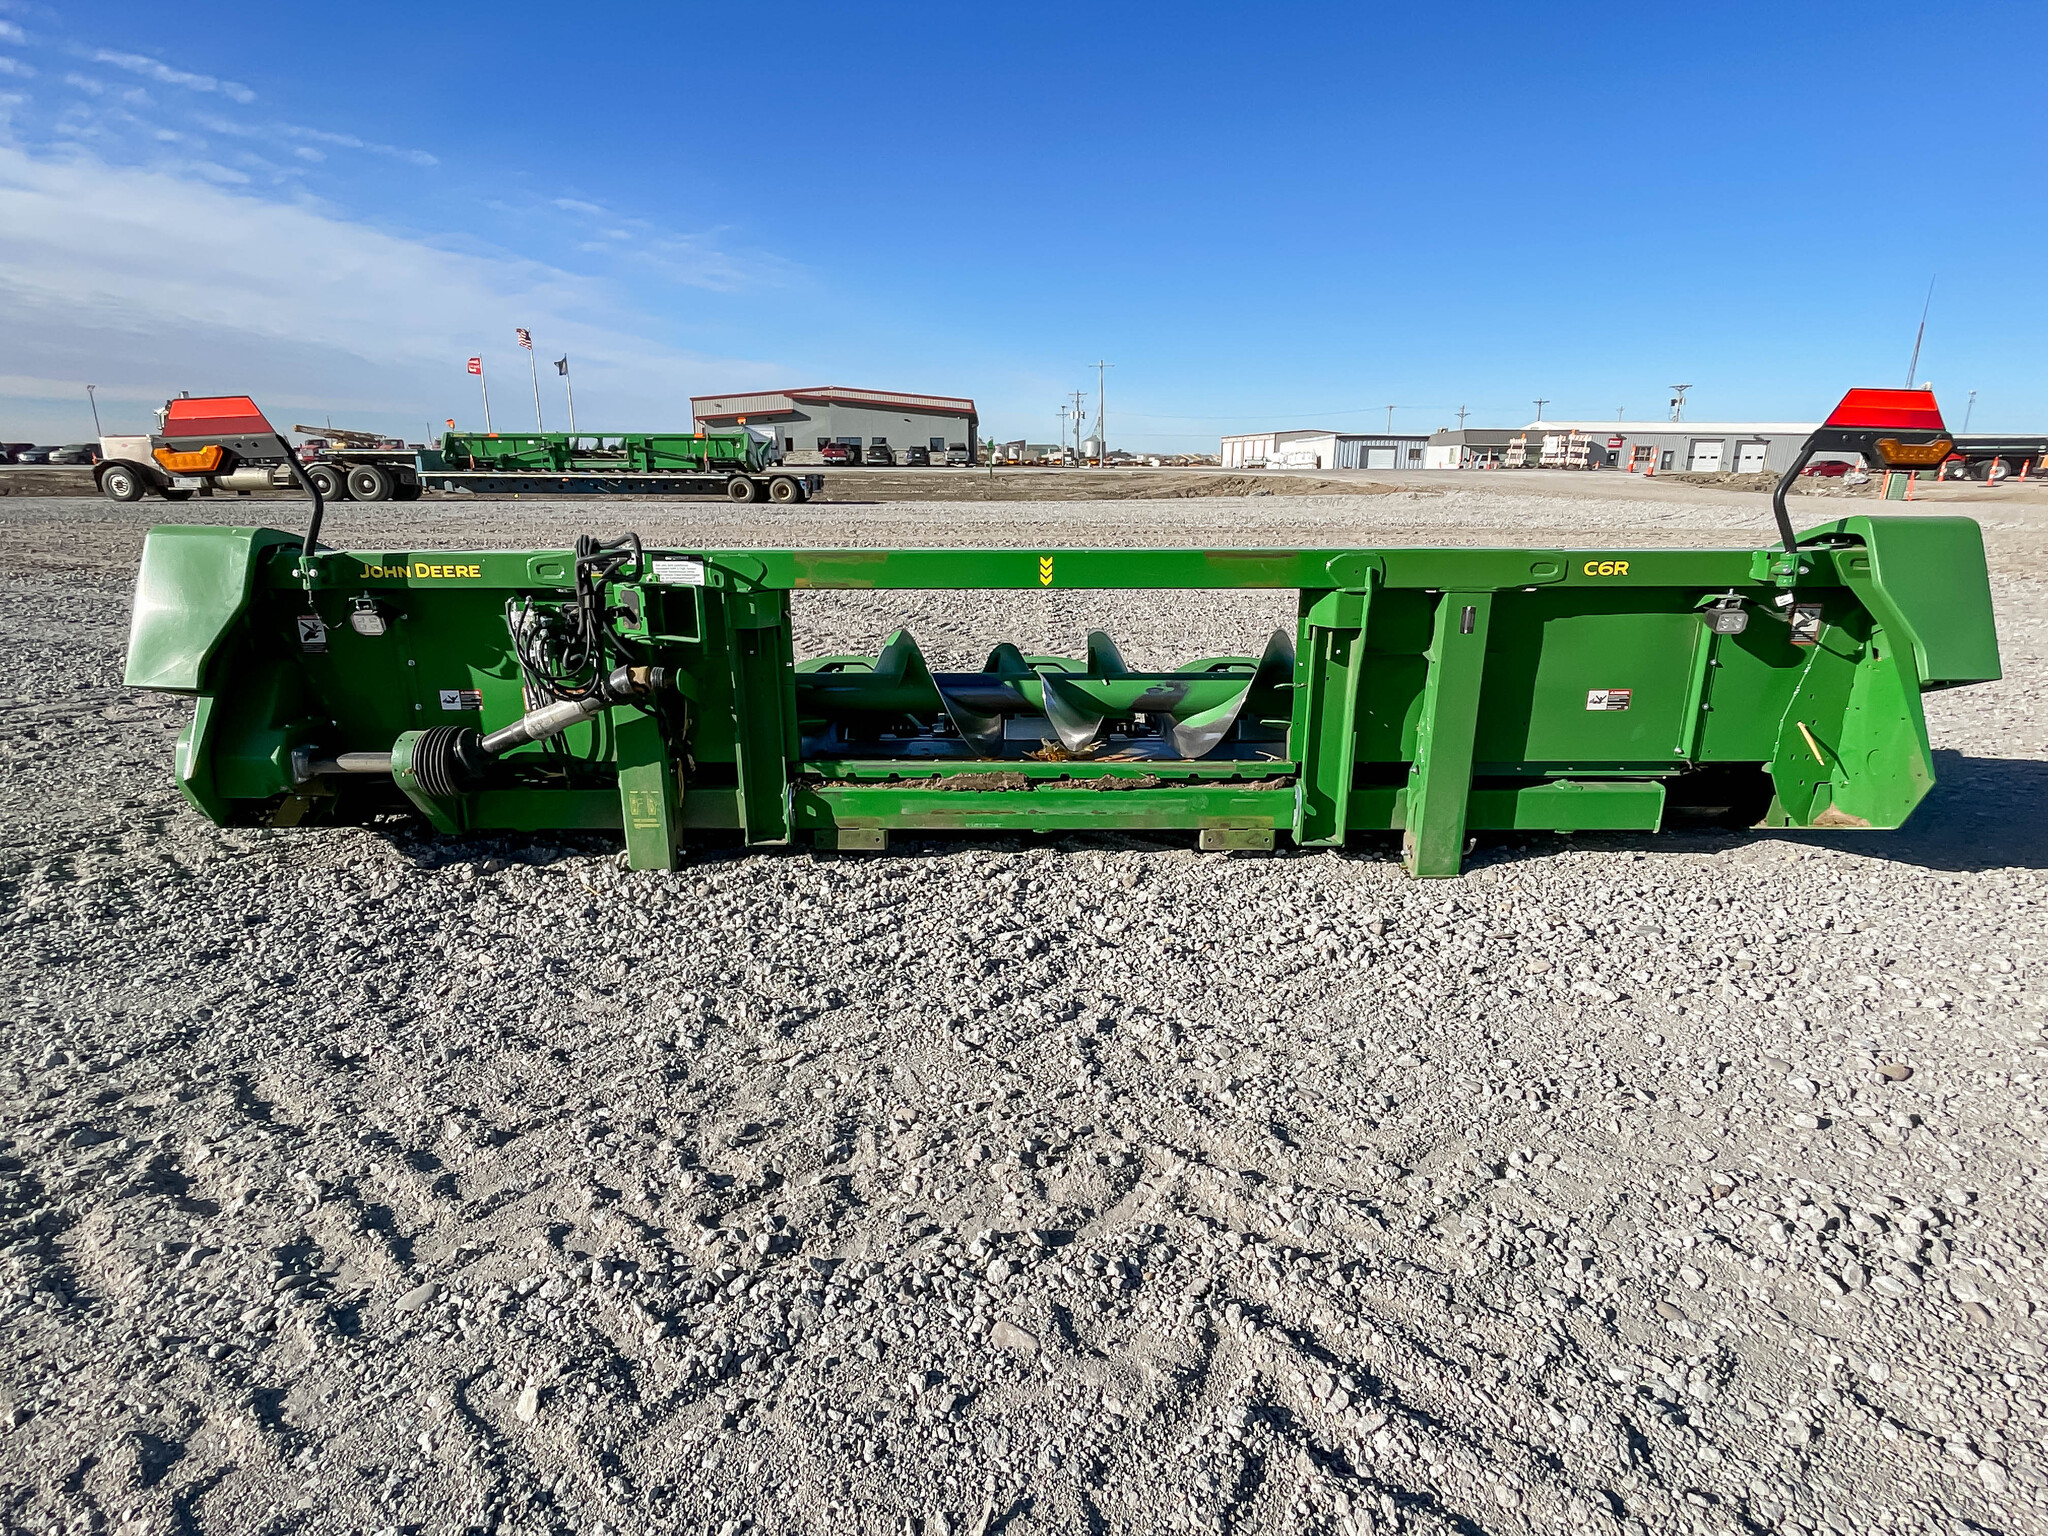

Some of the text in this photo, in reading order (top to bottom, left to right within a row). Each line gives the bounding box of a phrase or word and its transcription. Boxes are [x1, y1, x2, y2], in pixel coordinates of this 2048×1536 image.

[359, 562, 482, 579] JOHN DEERE
[1583, 561, 1630, 576] C6R
